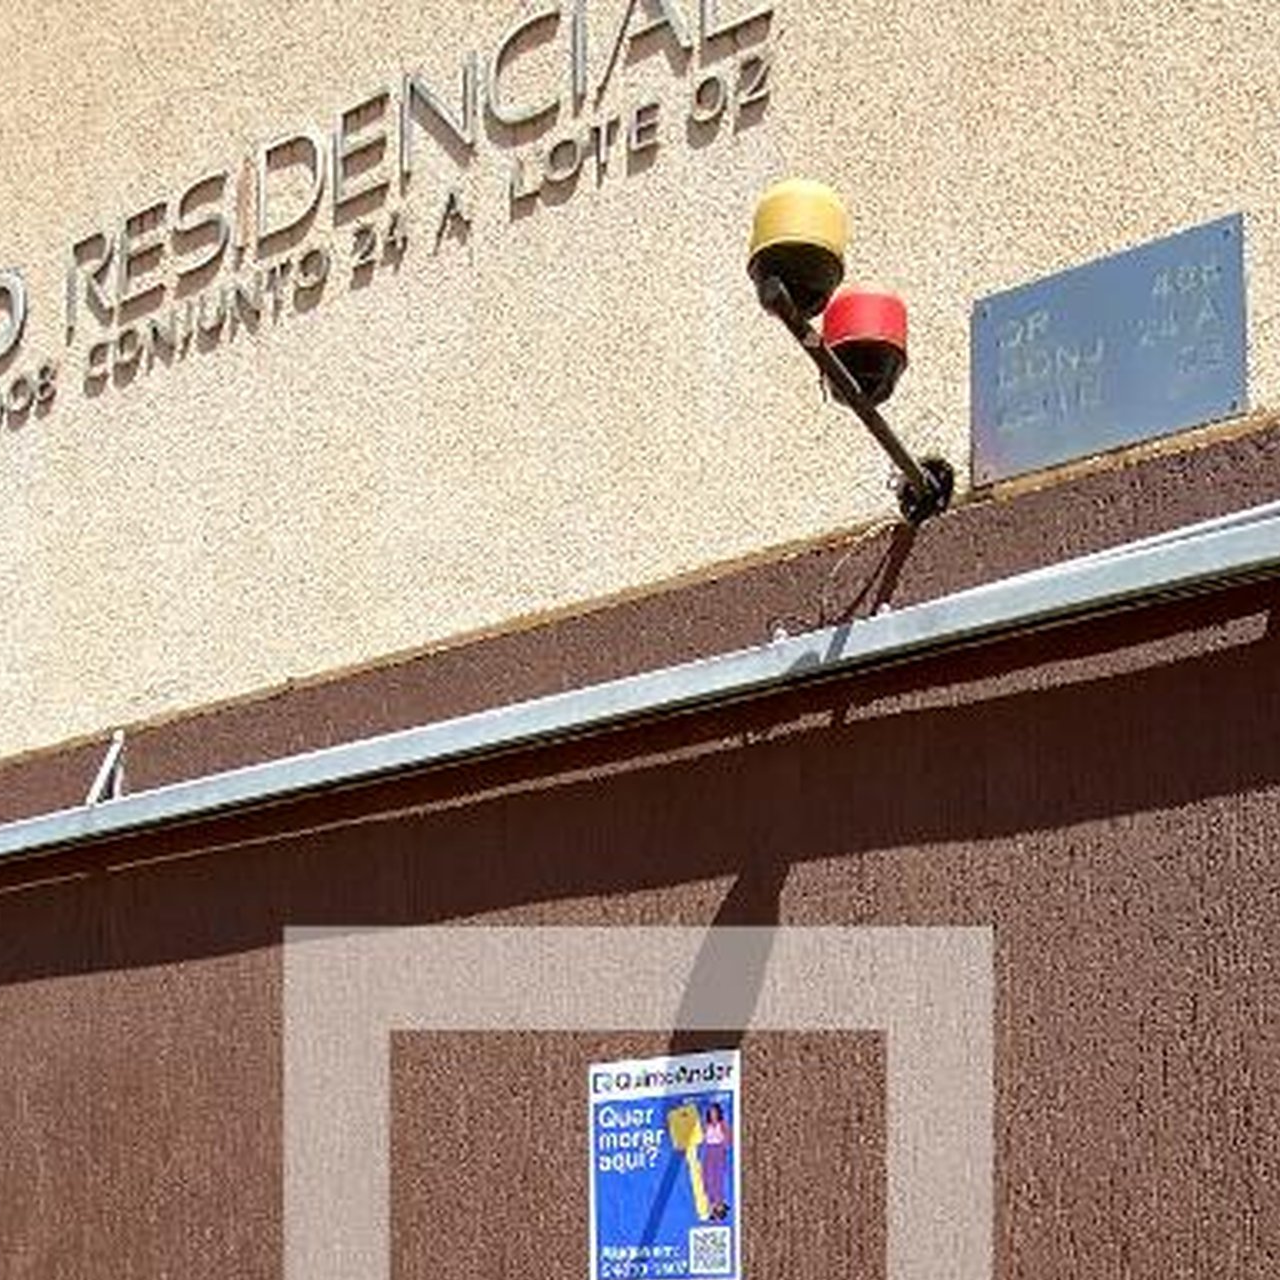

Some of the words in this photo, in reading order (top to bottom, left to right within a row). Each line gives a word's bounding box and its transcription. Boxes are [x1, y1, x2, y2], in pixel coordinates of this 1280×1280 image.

[84, 244, 330, 388] CONJUNTO
[350, 211, 408, 280] 24
[432, 188, 471, 256] A
[510, 94, 661, 215] LOTE
[687, 52, 773, 140] 02
[598, 1105, 655, 1129] Quer
[598, 1129, 666, 1150] morar
[598, 1147, 658, 1174] aqui?
